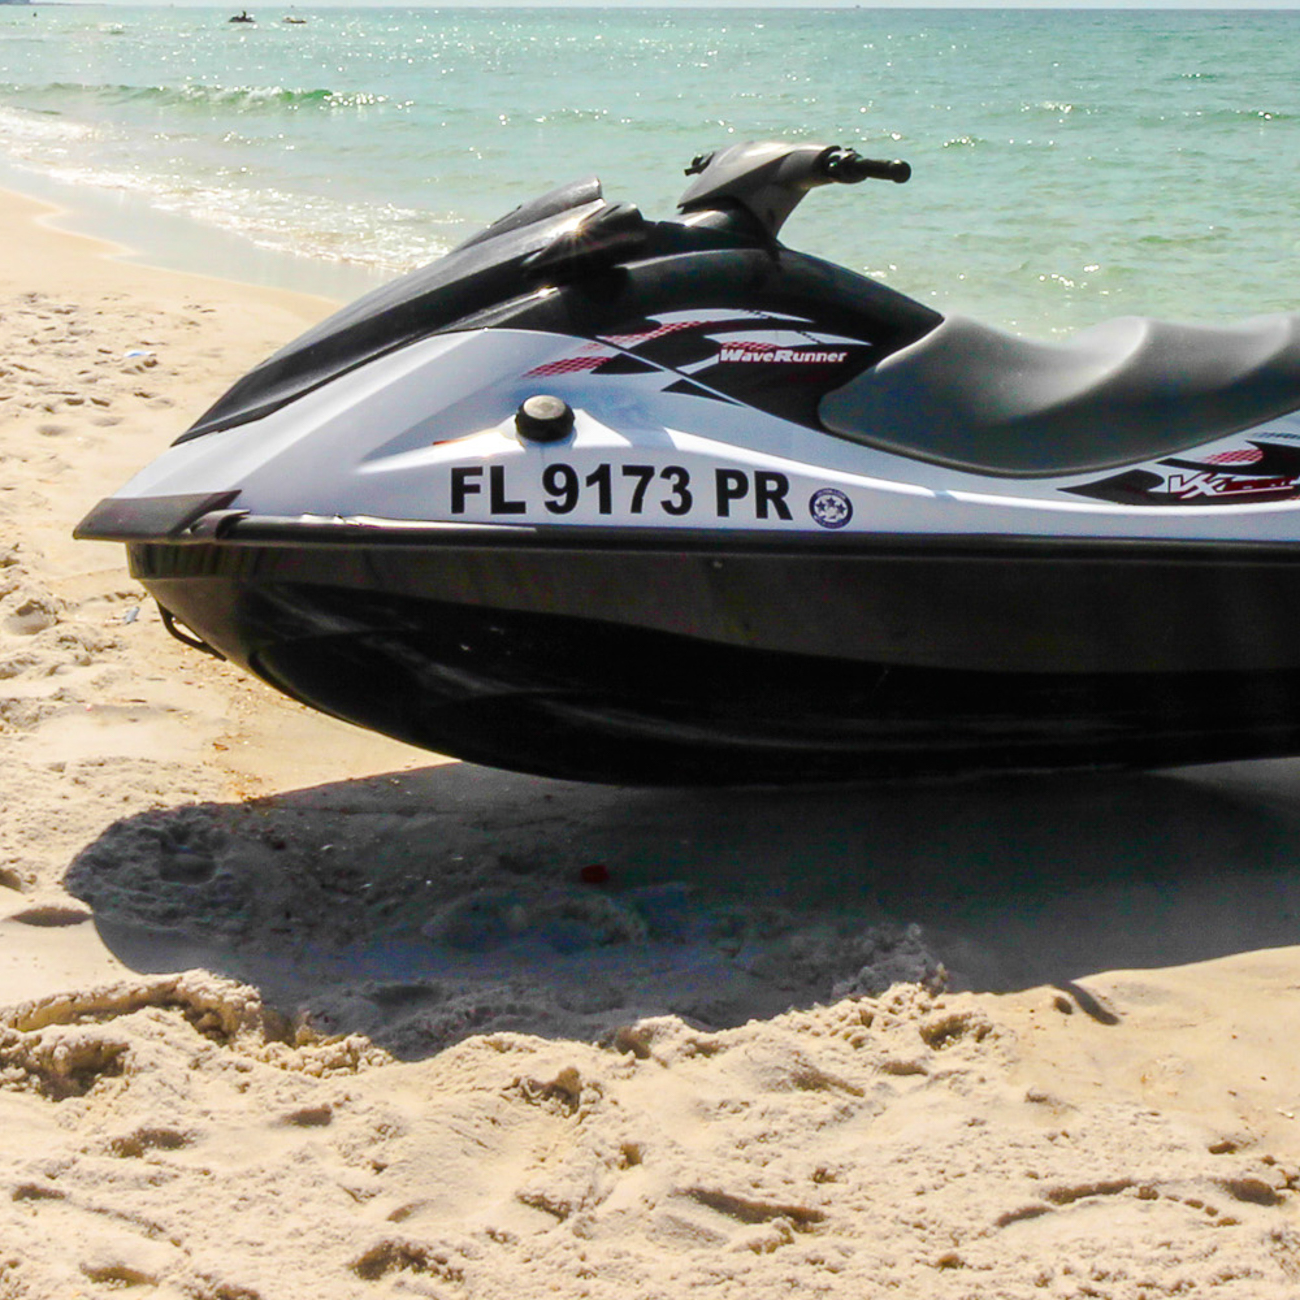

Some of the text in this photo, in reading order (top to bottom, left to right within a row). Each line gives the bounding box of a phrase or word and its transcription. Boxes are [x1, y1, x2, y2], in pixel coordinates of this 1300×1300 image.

[720, 349, 848, 363] WaveRunner
[451, 465, 526, 515] FL
[542, 463, 693, 516] 9173
[715, 469, 793, 520] PR
